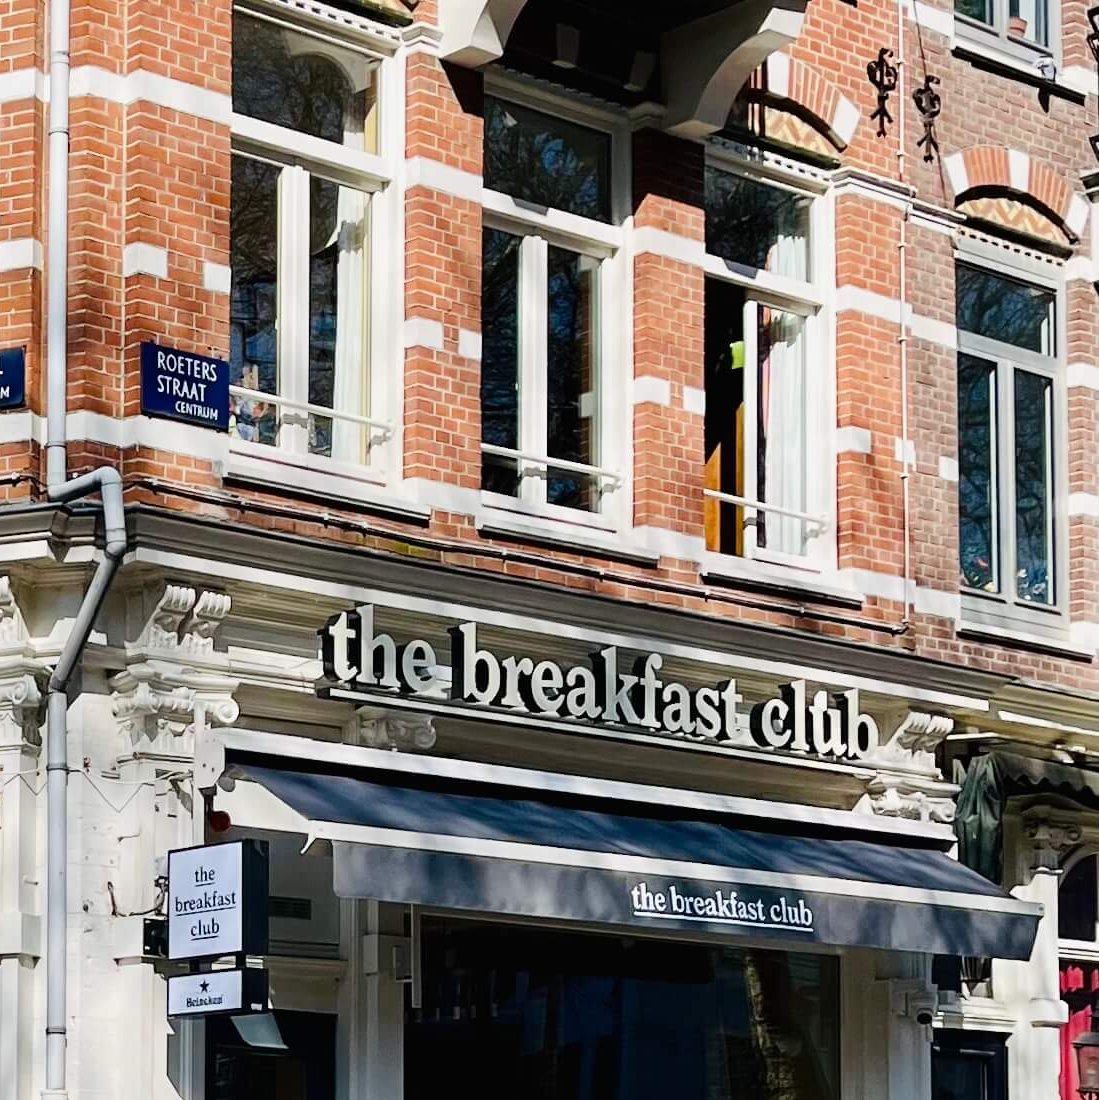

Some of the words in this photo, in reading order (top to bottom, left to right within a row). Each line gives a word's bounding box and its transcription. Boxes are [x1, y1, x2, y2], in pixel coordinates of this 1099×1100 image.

[157, 351, 217, 382] ROETERS
[157, 375, 206, 402] STRAAT
[175, 400, 219, 421] CENTRUM
[324, 603, 438, 693] the
[452, 621, 743, 742] breakfast
[755, 679, 880, 761] club
[194, 866, 216, 883] the
[175, 890, 237, 913] breakfast
[631, 882, 666, 911] the
[669, 885, 766, 921] breakfast
[770, 897, 813, 926] club
[190, 917, 220, 937] club
[186, 995, 224, 1008] Heineken
